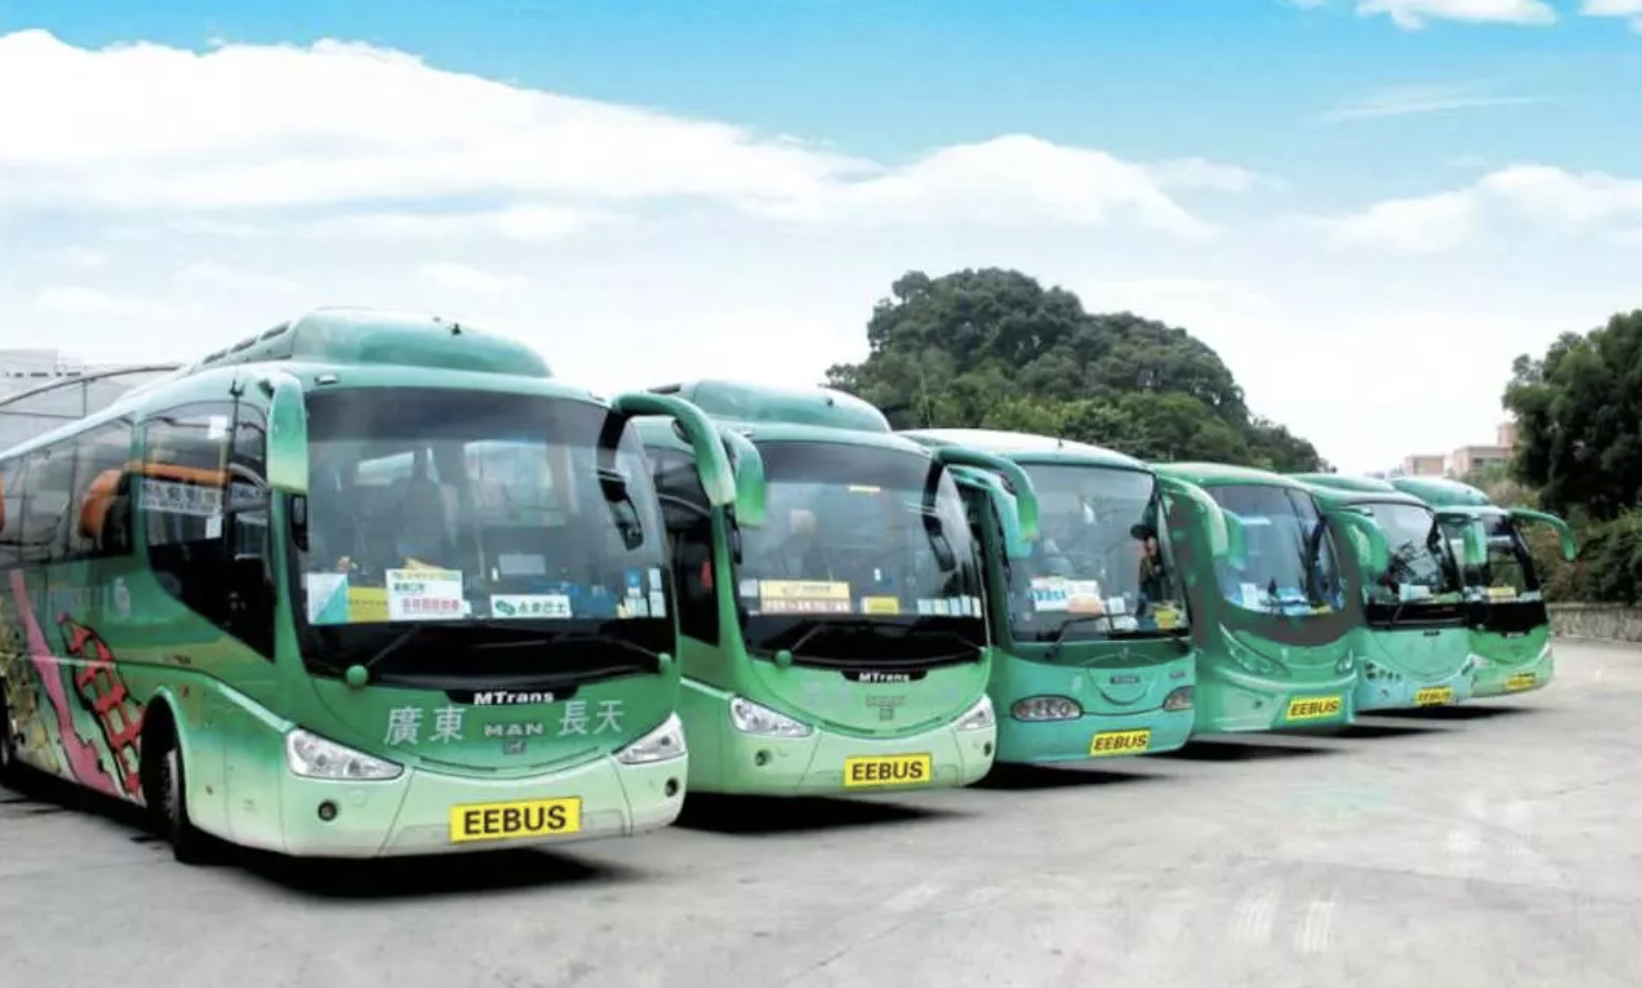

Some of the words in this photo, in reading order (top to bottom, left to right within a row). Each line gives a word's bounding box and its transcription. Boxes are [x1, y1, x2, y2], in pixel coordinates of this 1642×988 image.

[859, 672, 911, 683] MTrans
[474, 691, 554, 705] MTrans
[1290, 698, 1339, 716] EEBUS
[383, 705, 466, 745] 廣東
[557, 700, 626, 737] 長天
[483, 722, 544, 737] MAN
[1094, 734, 1147, 751] EEBUS
[852, 761, 923, 781] EEBUS
[464, 805, 567, 835] EEBUS
